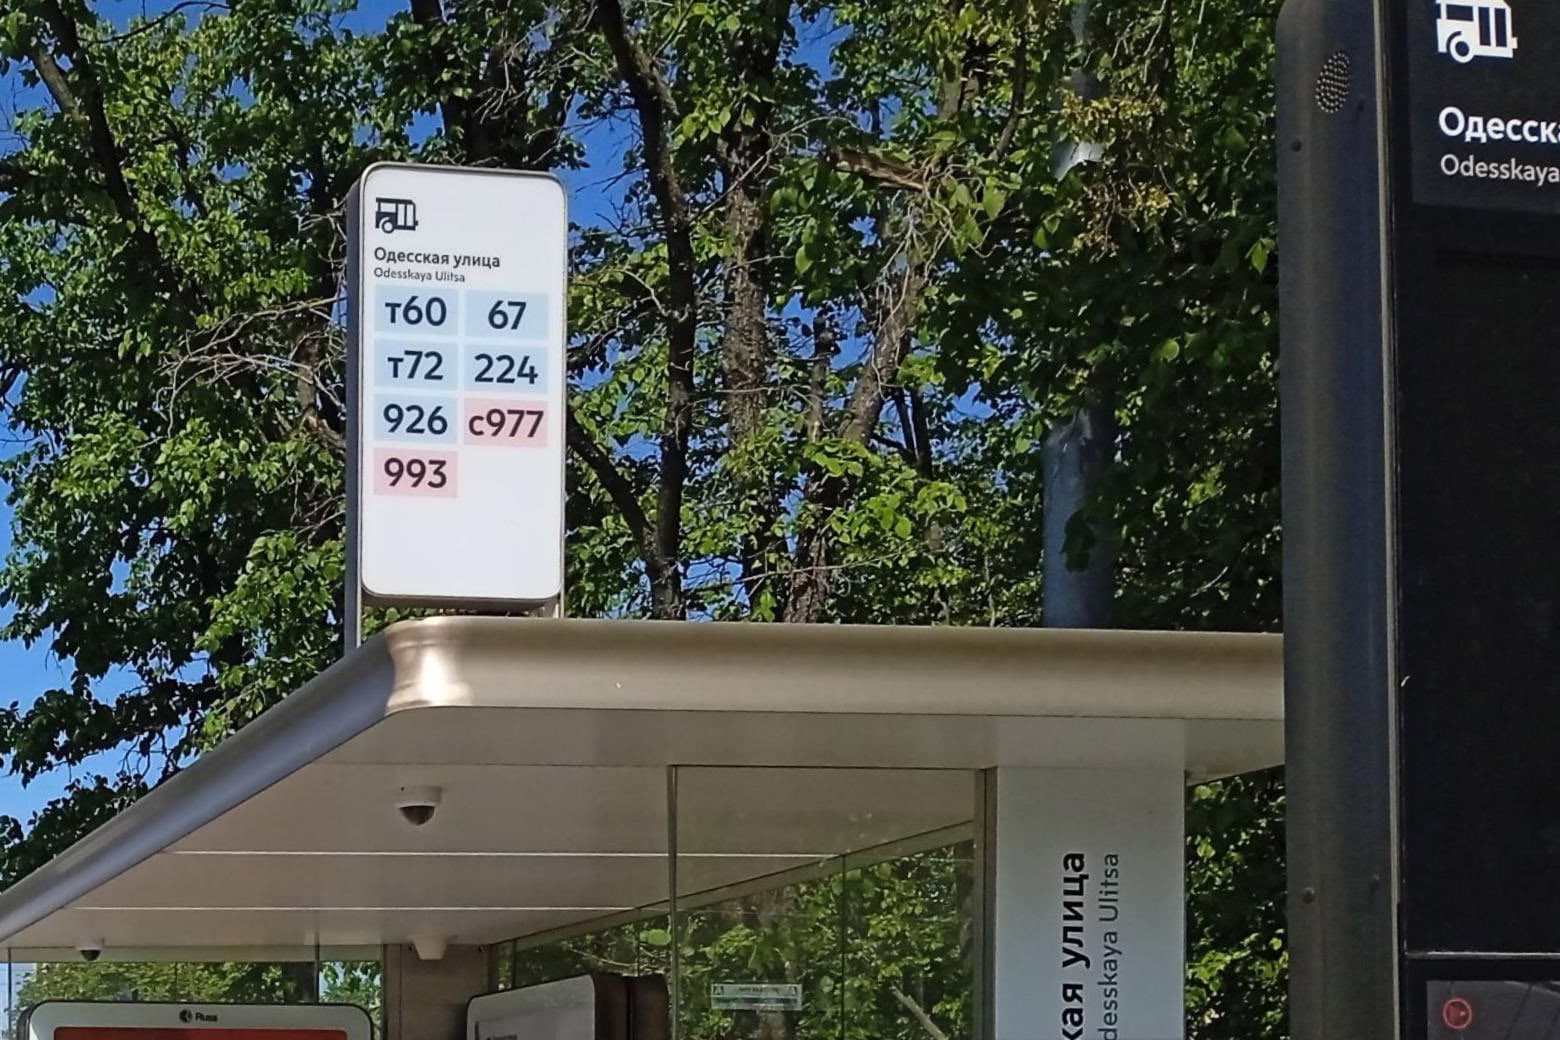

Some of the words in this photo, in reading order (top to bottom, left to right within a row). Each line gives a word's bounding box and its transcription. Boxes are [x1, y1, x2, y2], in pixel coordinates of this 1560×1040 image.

[1438, 106, 1560, 143] Одесск
[1440, 153, 1560, 187] Odesskaya
[373, 246, 450, 264] Одесская
[452, 254, 501, 269] улица
[373, 266, 433, 282] Odesskaya
[435, 270, 465, 282] Ulitsa
[384, 295, 447, 327] т60
[487, 299, 527, 330] 67
[387, 350, 444, 380] т72
[474, 353, 539, 384] 224
[383, 403, 448, 435] 926
[468, 408, 544, 438] с977
[383, 457, 447, 488] 993
[1097, 852, 1120, 923] Ulitsa
[1061, 851, 1091, 968] улица
